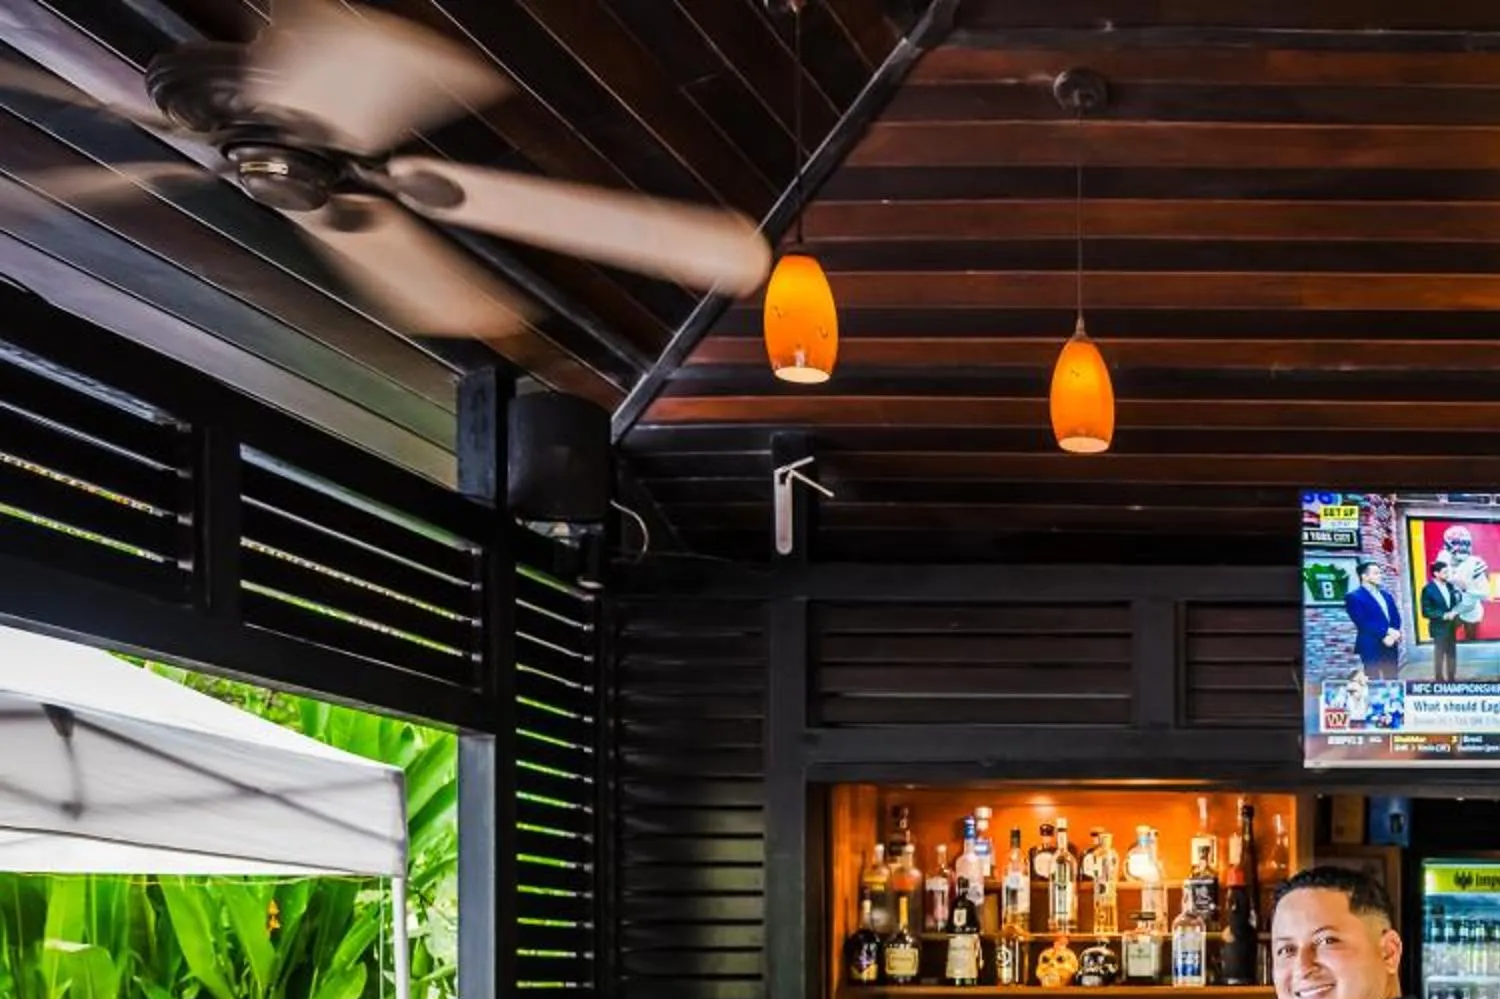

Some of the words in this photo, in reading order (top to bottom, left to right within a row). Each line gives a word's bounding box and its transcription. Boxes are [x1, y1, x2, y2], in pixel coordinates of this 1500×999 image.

[1412, 683, 1432, 694] NFC
[1413, 701, 1441, 713] What
[1443, 701, 1478, 713] should
